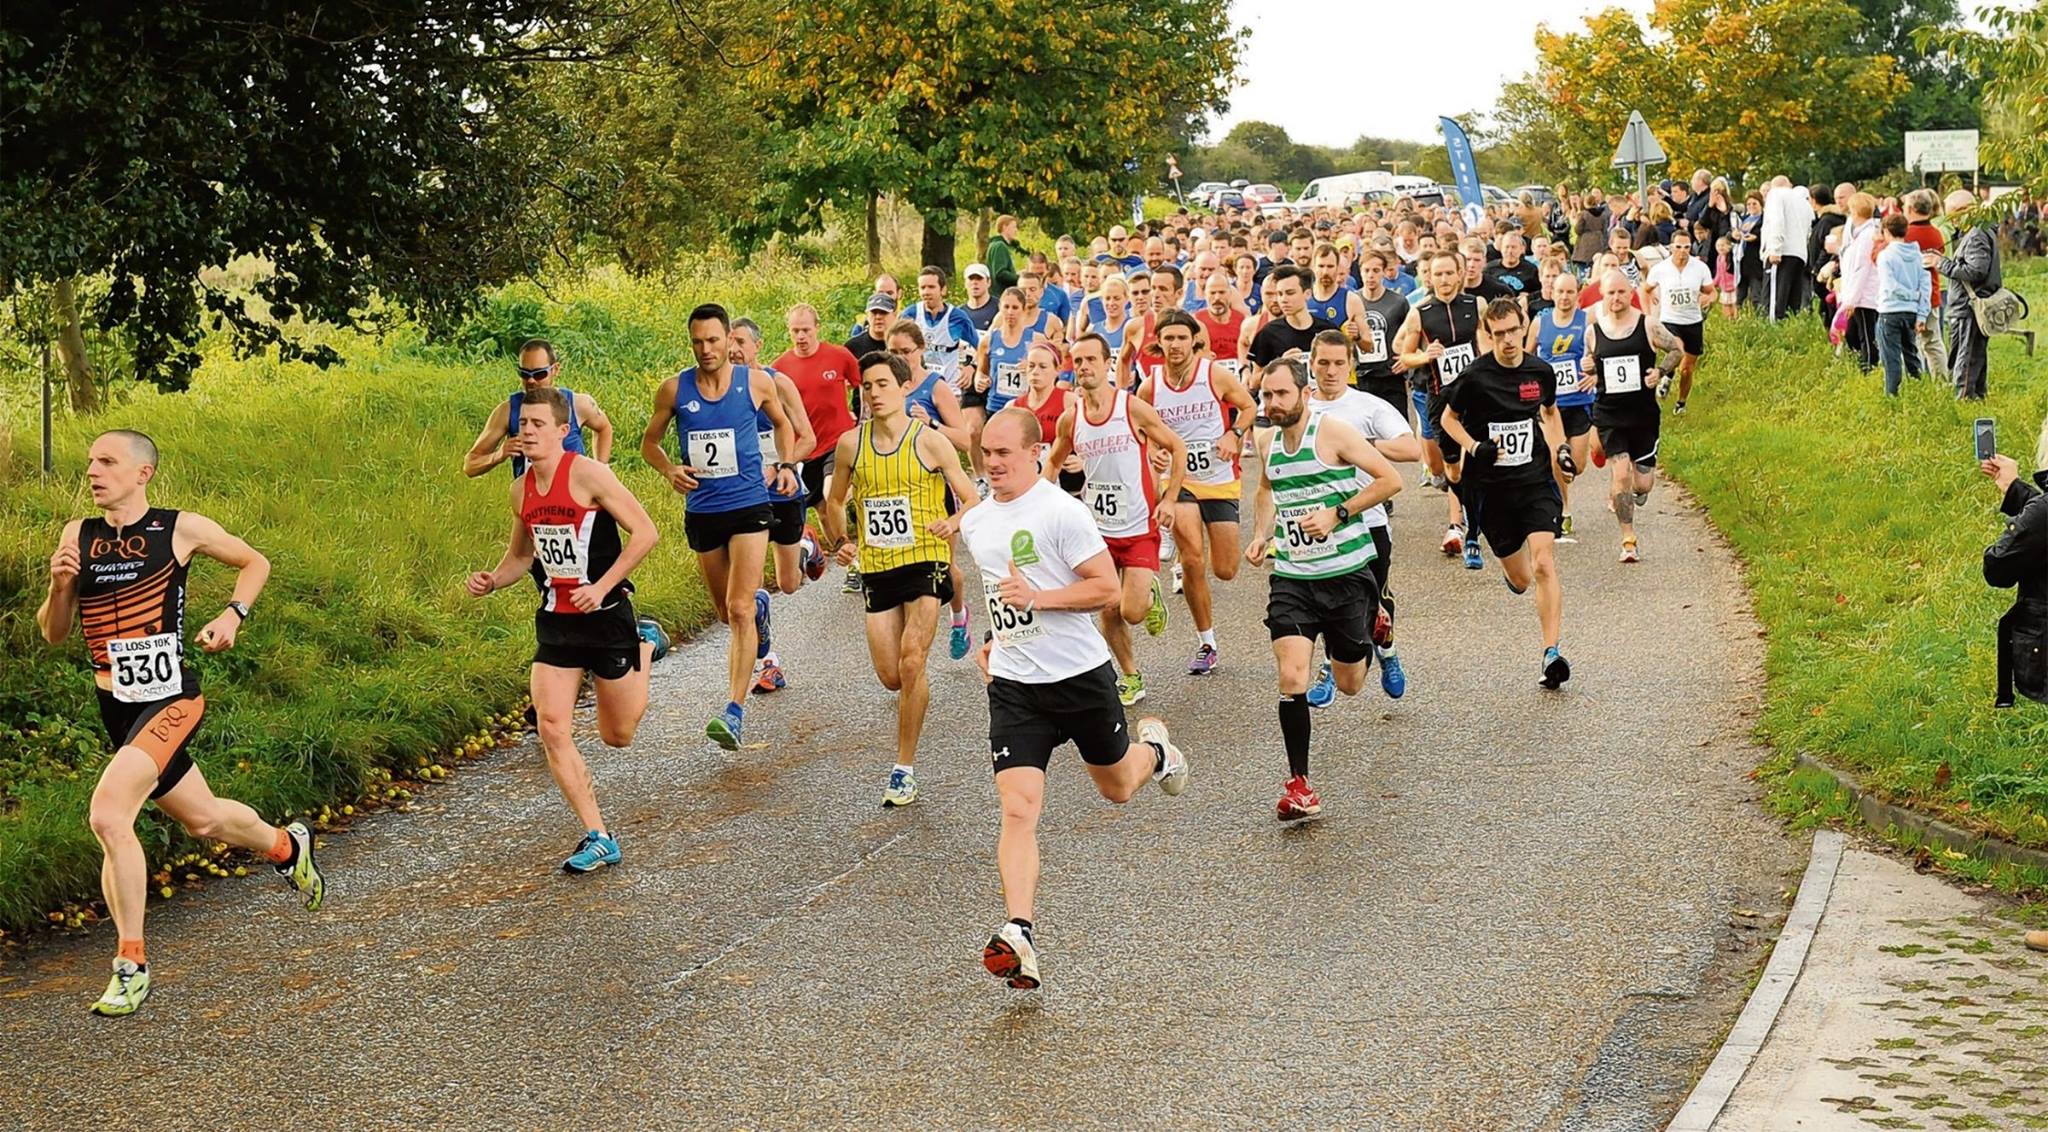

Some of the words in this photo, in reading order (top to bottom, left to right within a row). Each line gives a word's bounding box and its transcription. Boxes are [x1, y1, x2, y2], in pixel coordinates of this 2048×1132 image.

[1670, 292, 1691, 305] 203
[1006, 372, 1020, 388] 14
[1617, 365, 1626, 383] 9
[1157, 400, 1214, 418] ENFLEET
[705, 442, 719, 467] 2
[525, 505, 576, 522] OUTHEND
[1094, 493, 1117, 516] 45
[1290, 507, 1307, 517] LOSS
[868, 509, 908, 536] 536
[539, 538, 577, 565] 364
[126, 640, 151, 651] LOSS
[153, 636, 171, 648] 10K
[116, 651, 173, 686] 530
